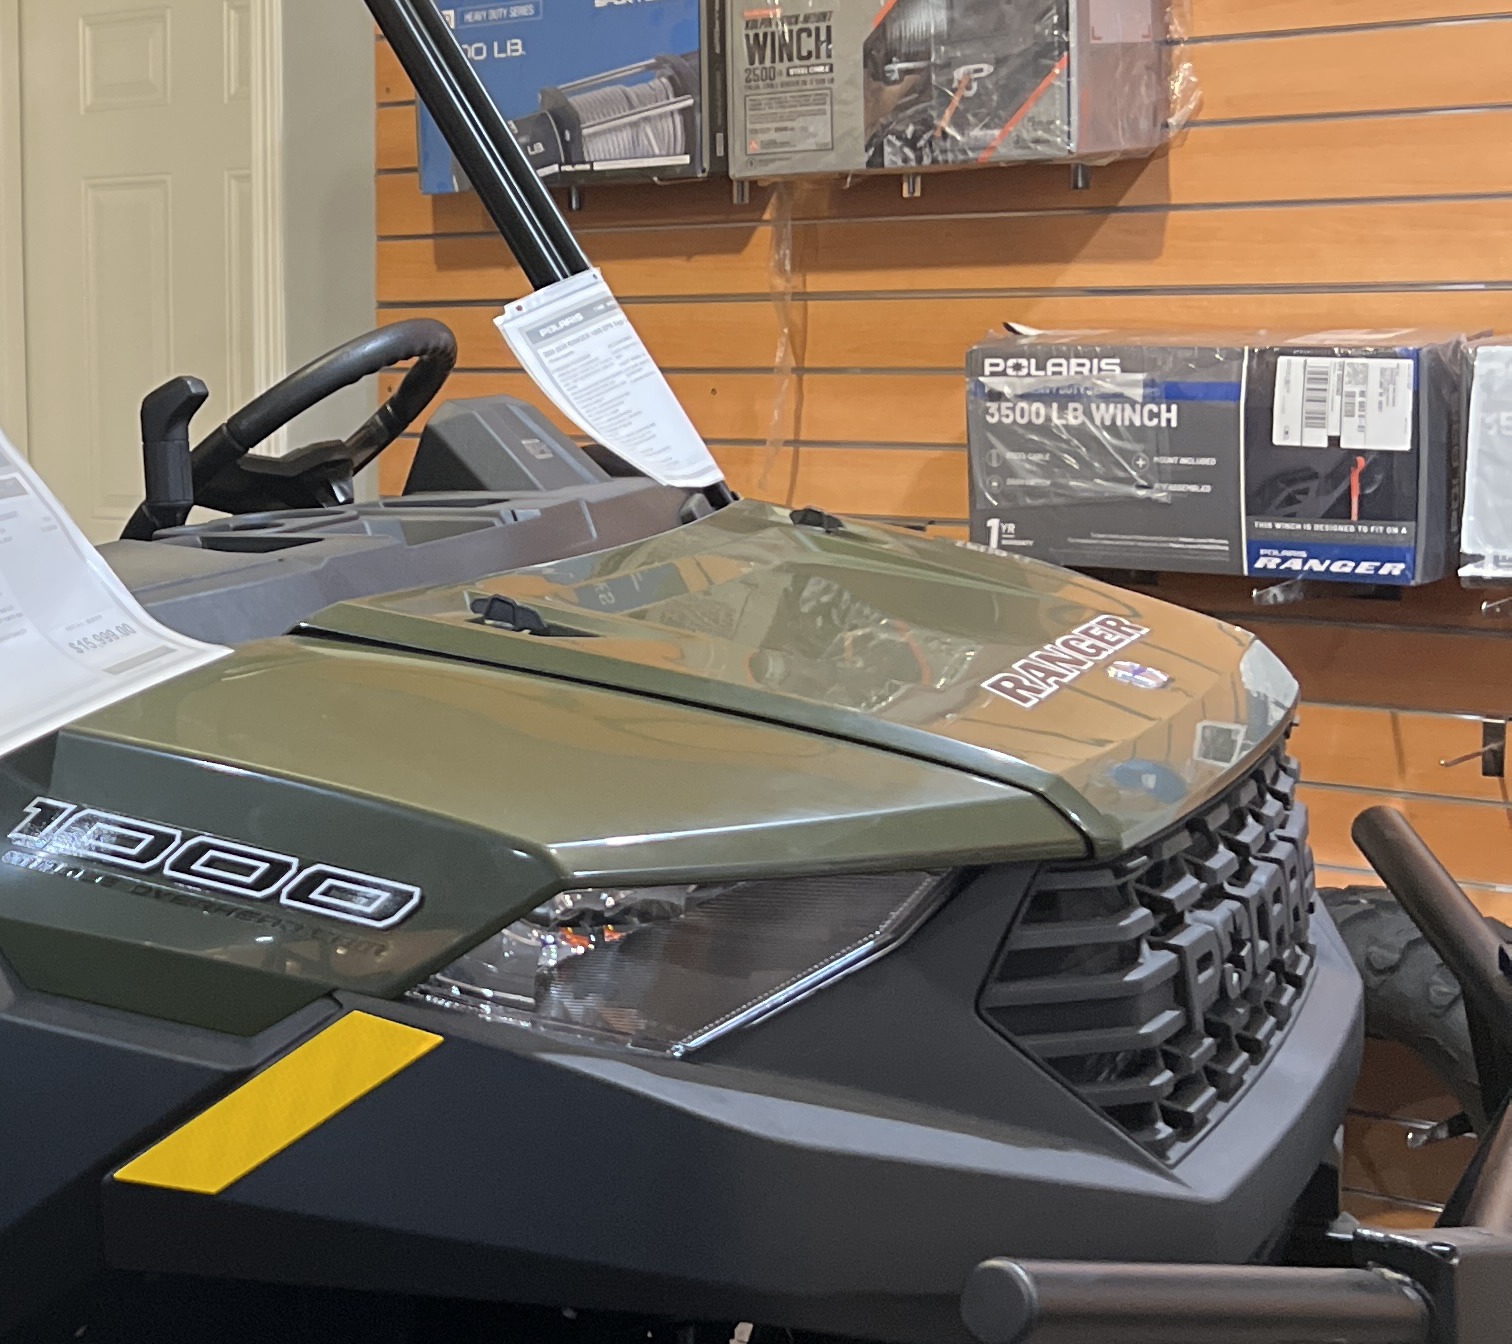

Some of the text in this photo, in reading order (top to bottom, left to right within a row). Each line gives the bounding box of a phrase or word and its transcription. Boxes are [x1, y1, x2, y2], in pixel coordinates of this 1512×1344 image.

[744, 25, 833, 66] WINCH
[744, 66, 777, 84] 2500
[984, 358, 1121, 376] POLARIS
[985, 402, 1178, 428] 3500 LB WINCH
[986, 518, 1001, 548] 1
[1274, 522, 1301, 530] WINCH
[1303, 522, 1312, 530] IS
[1313, 523, 1355, 533] DESIGNED
[1357, 524, 1368, 533] TO
[1370, 526, 1384, 534] FIT
[1386, 526, 1399, 534] ON
[1254, 557, 1406, 576] RANGER
[68, 622, 137, 654] $15,999.00
[980, 614, 1151, 708] RANGER
[6, 795, 424, 931] 1000
